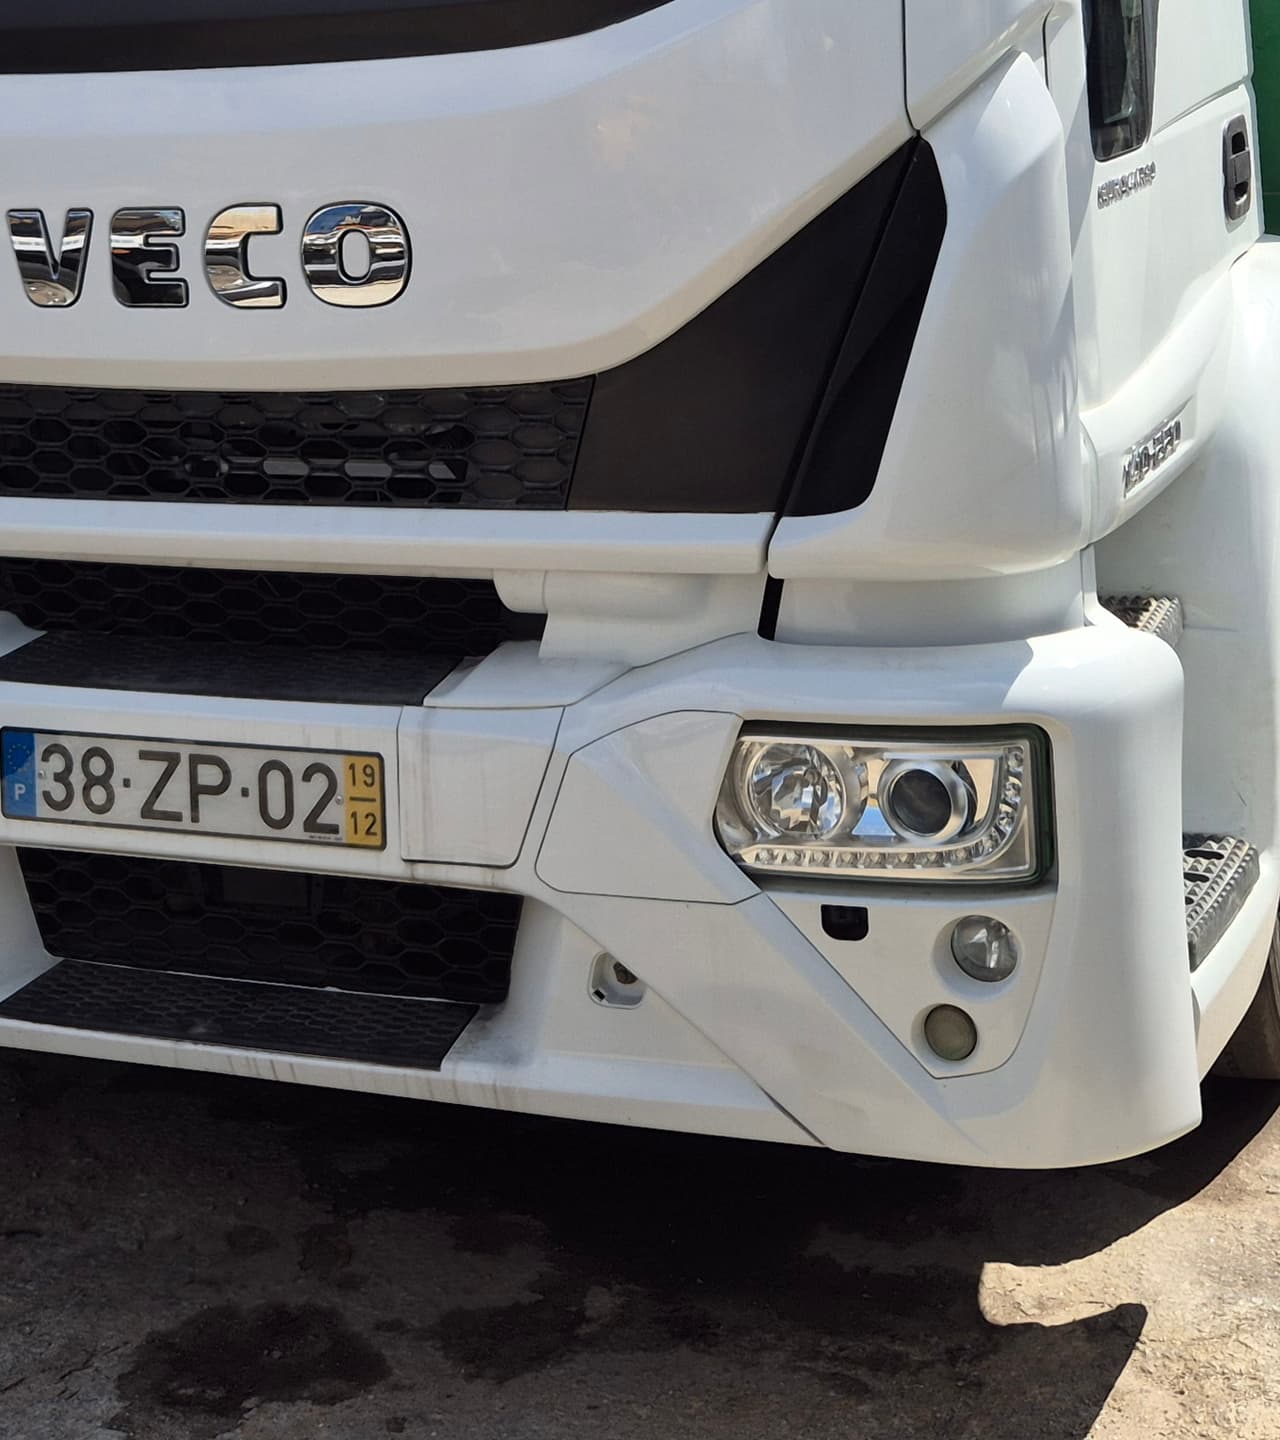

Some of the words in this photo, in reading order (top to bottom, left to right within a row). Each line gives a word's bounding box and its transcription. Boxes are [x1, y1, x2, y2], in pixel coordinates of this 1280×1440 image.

[348, 763, 375, 787] 19
[14, 783, 26, 801] P
[350, 811, 377, 836] 12
